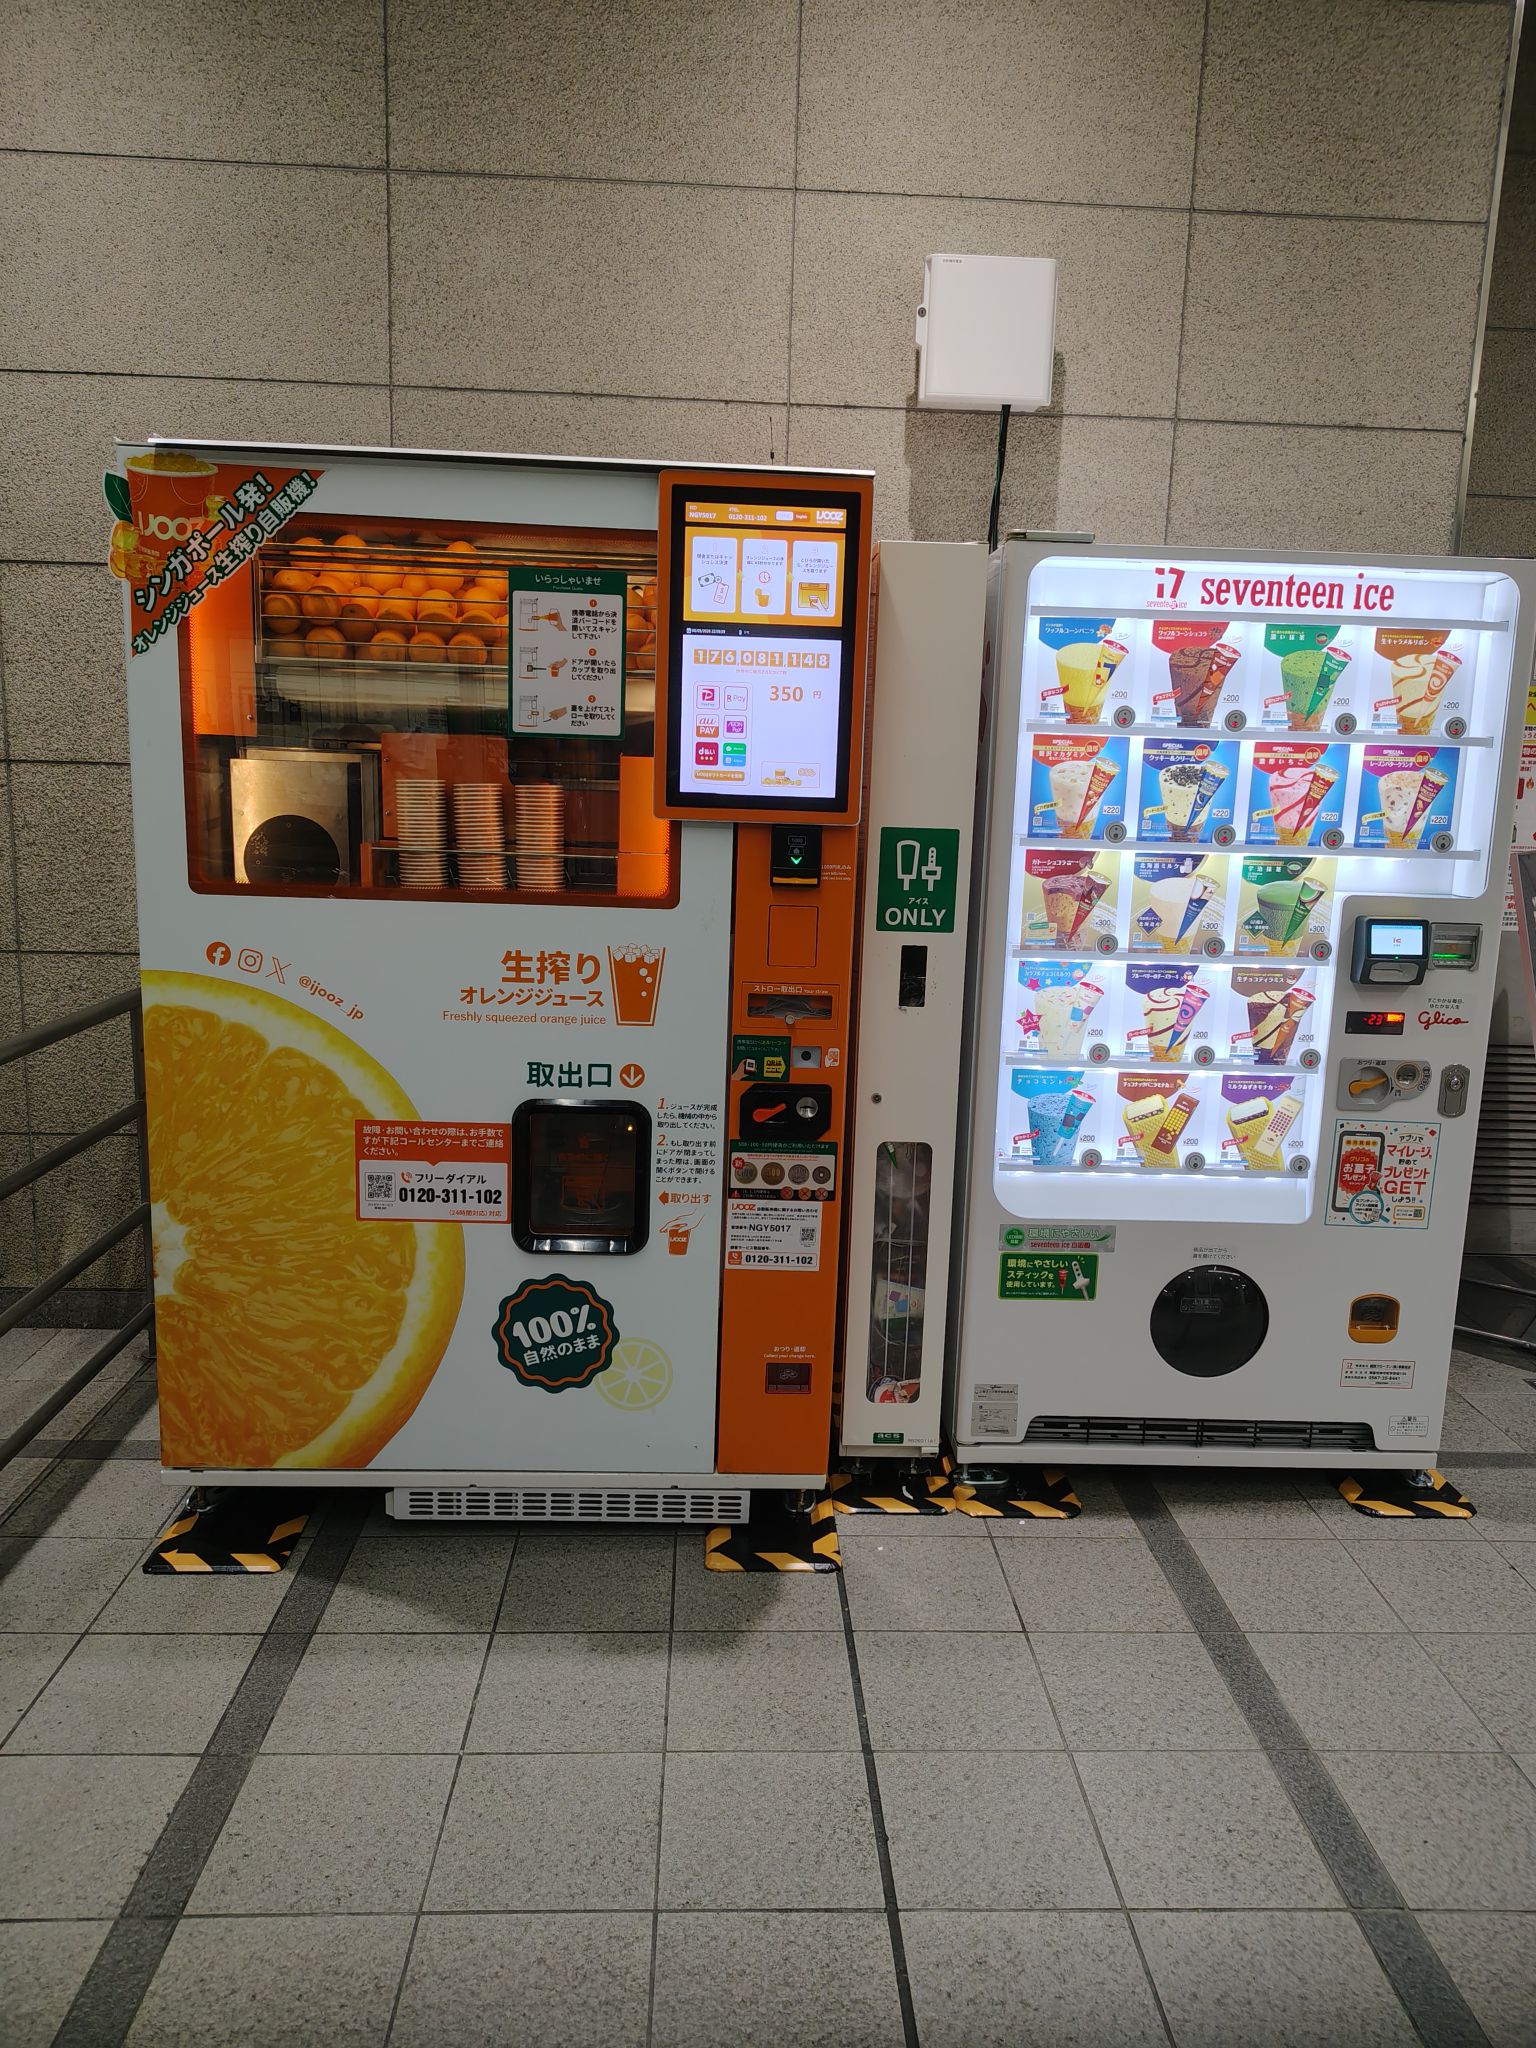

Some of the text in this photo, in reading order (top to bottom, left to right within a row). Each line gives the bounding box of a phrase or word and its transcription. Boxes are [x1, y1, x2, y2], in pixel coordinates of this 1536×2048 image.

[728, 513, 767, 521] 0120-311-102
[135, 472, 275, 612] シンガポール発!
[132, 470, 318, 654] オレンジジュース生搾り自販機!
[535, 574, 602, 586] いらっしゃいませ
[1201, 572, 1395, 611] seventeen ice
[1045, 627, 1095, 635] ワッフルコーンバニラ
[1158, 629, 1208, 638] ワッフルコーンショコラ
[769, 685, 804, 702] 350
[699, 726, 716, 735] PAY
[908, 897, 929, 905] アイス
[885, 907, 947, 926] ONLY
[500, 949, 602, 985] 生搾り
[753, 985, 803, 993] ストロー取出口
[299, 975, 364, 1020] @ijooz_jp
[459, 986, 605, 1008] オレンジジュース
[442, 1010, 606, 1026] Freshly squeezed orange juice
[1418, 1011, 1469, 1030] Glico
[526, 1061, 612, 1088] 取出口
[670, 1103, 718, 1112] ジュースが完成
[656, 1121, 716, 1129] 取り出してください。
[363, 1136, 504, 1149] すが下記コールセンターまでご連絡
[670, 1140, 717, 1148] もし取り出す前
[1399, 1134, 1424, 1143] アプリで
[363, 1147, 399, 1157] ください。
[1343, 1163, 1376, 1174] お菓子
[1383, 1167, 1430, 1179] プレゼント
[414, 1172, 487, 1185] フリーダイアル
[655, 1176, 702, 1184] ことができます。
[1342, 1173, 1367, 1181] プレゼント
[1383, 1181, 1427, 1195] GET
[399, 1187, 502, 1204] 0120-311-102
[670, 1193, 712, 1204] 取り出す
[748, 1223, 791, 1233] NGY5017
[1028, 1227, 1100, 1240] 環境にやさしい
[745, 1254, 813, 1265] 0120-311-102
[1006, 1258, 1069, 1269] 環境にやさしい
[1006, 1270, 1054, 1280] スティックを
[1005, 1280, 1056, 1289] 使用しています。
[512, 1304, 597, 1348] 100%
[523, 1334, 601, 1367] 自然のまま
